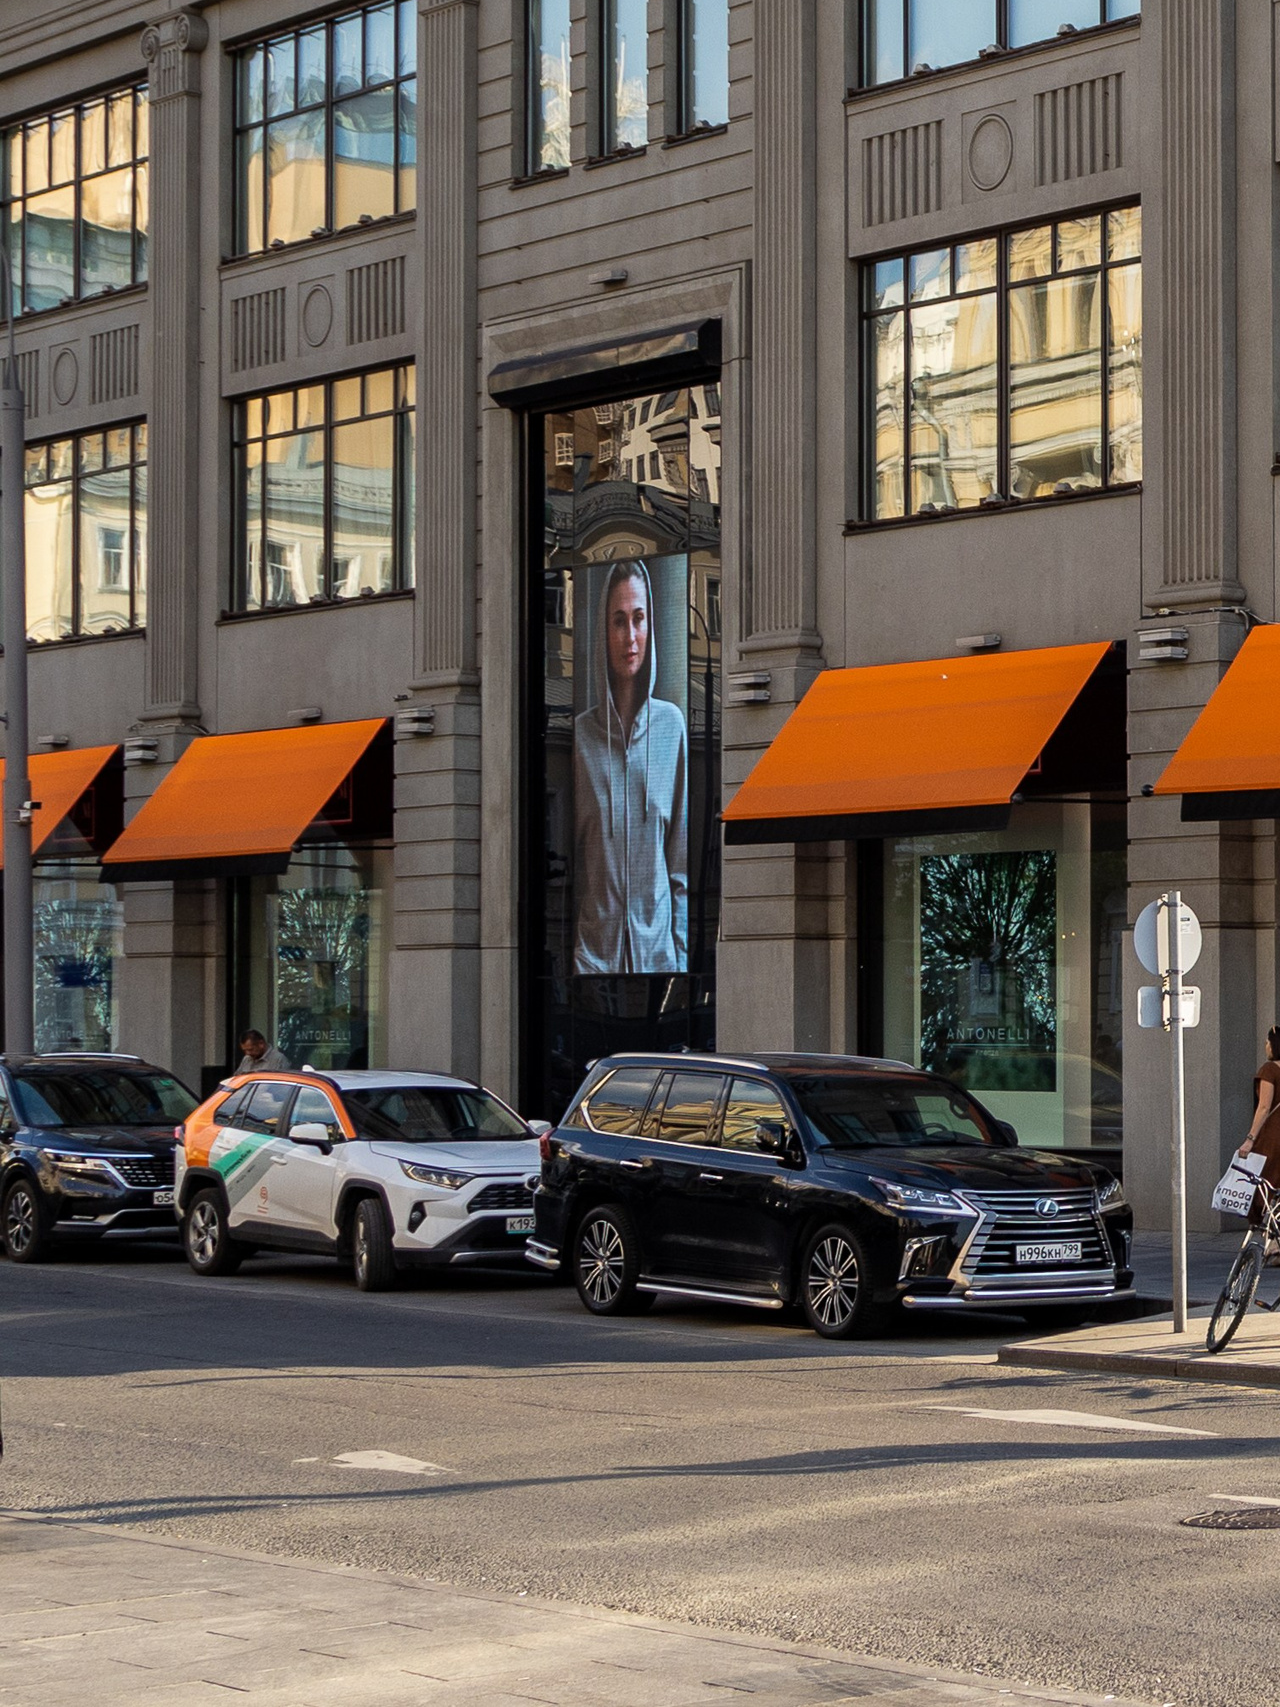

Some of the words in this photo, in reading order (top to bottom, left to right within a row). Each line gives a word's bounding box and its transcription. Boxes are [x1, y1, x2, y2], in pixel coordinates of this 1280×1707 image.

[295, 1030, 352, 1041] ANTONELLI
[946, 1027, 1030, 1040] ANTONELLI
[1221, 1187, 1253, 1202] moda
[1221, 1197, 1250, 1211] sport
[1062, 1243, 1079, 1255] 799
